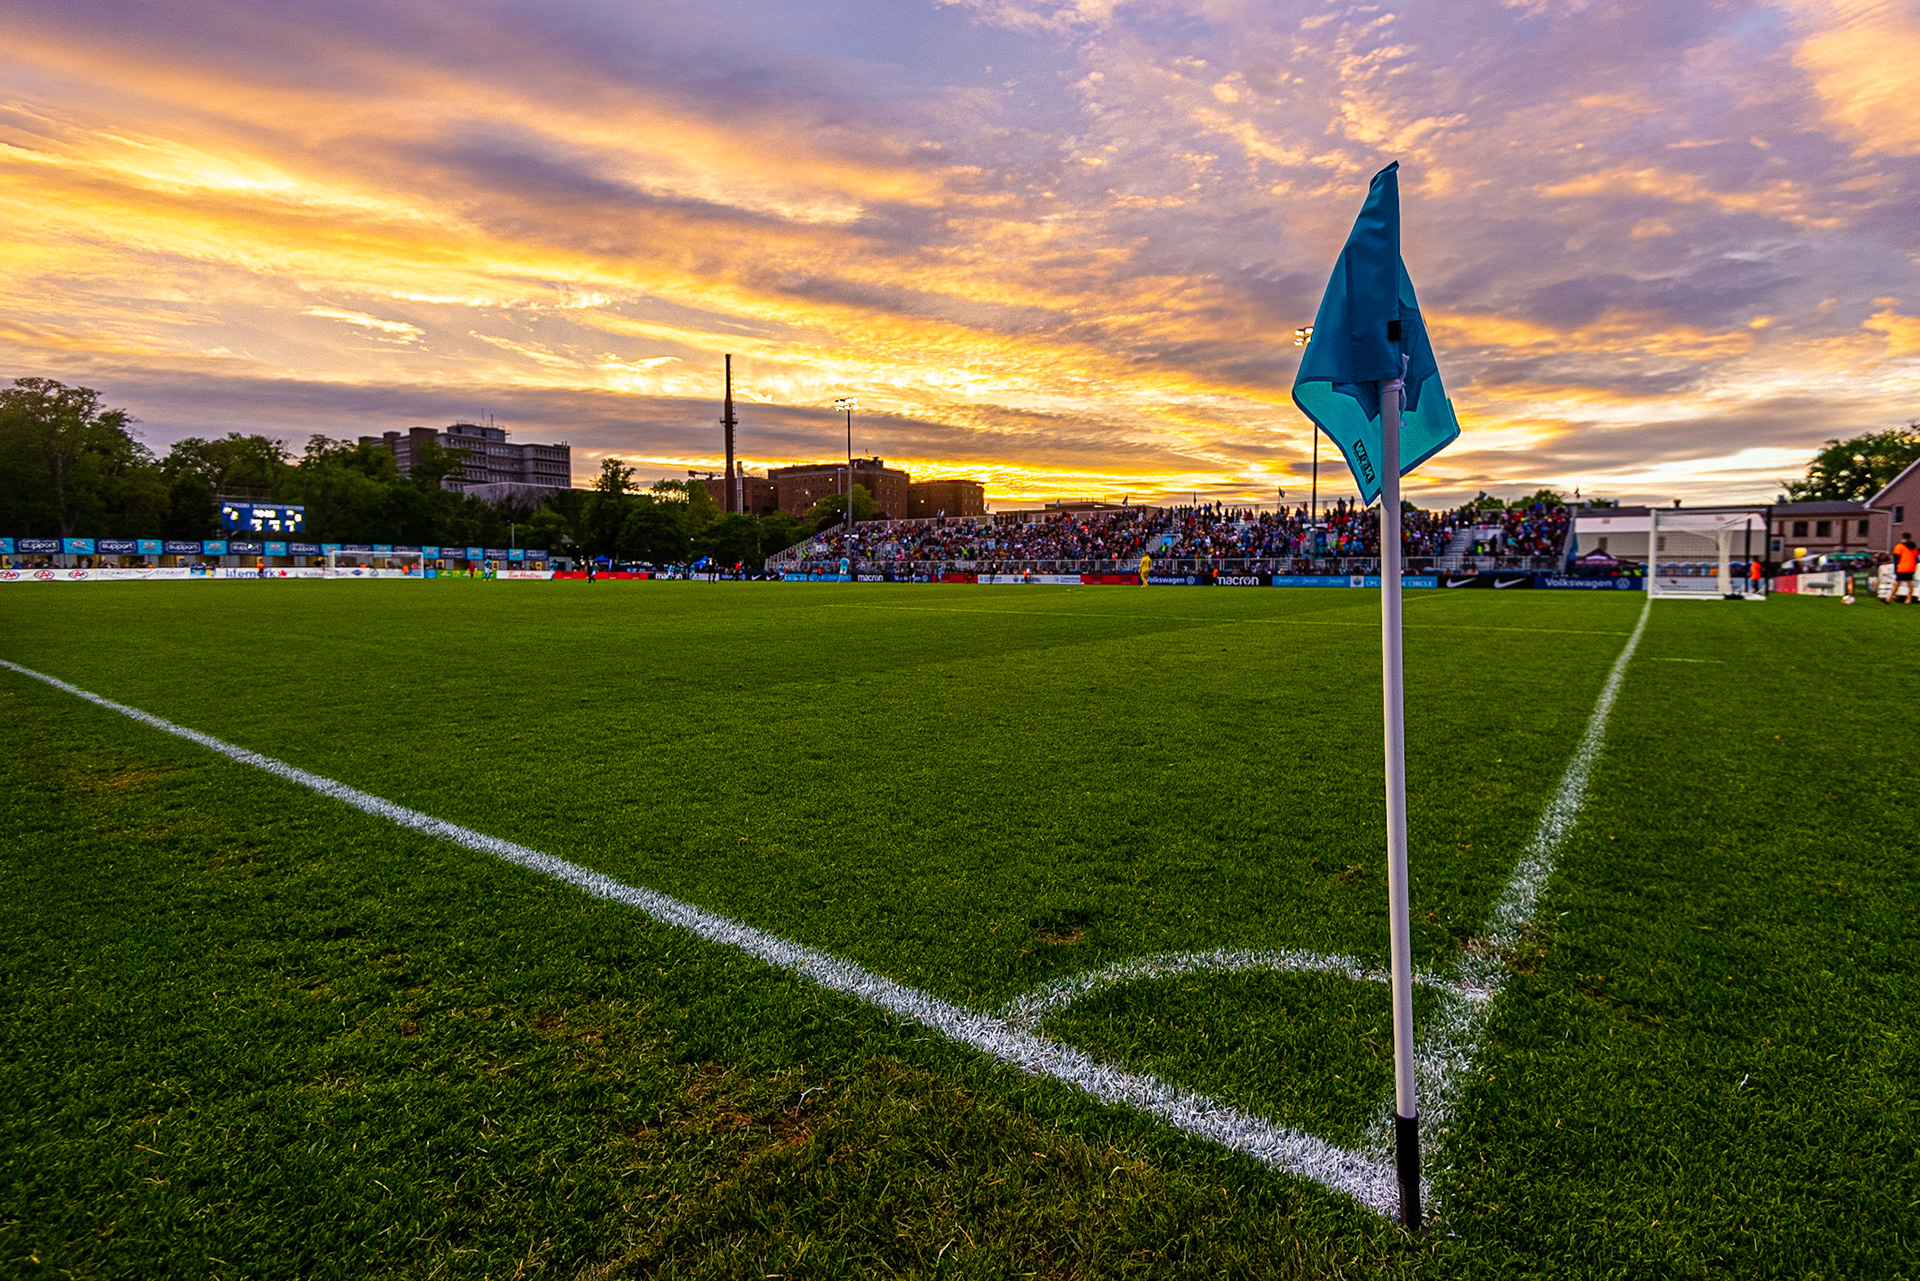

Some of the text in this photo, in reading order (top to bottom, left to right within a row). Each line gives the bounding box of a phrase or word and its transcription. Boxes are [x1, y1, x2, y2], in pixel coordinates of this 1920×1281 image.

[225, 568, 276, 578] lifemrk
[1217, 576, 1260, 585] macron
[1545, 578, 1612, 589] Volkswagen
